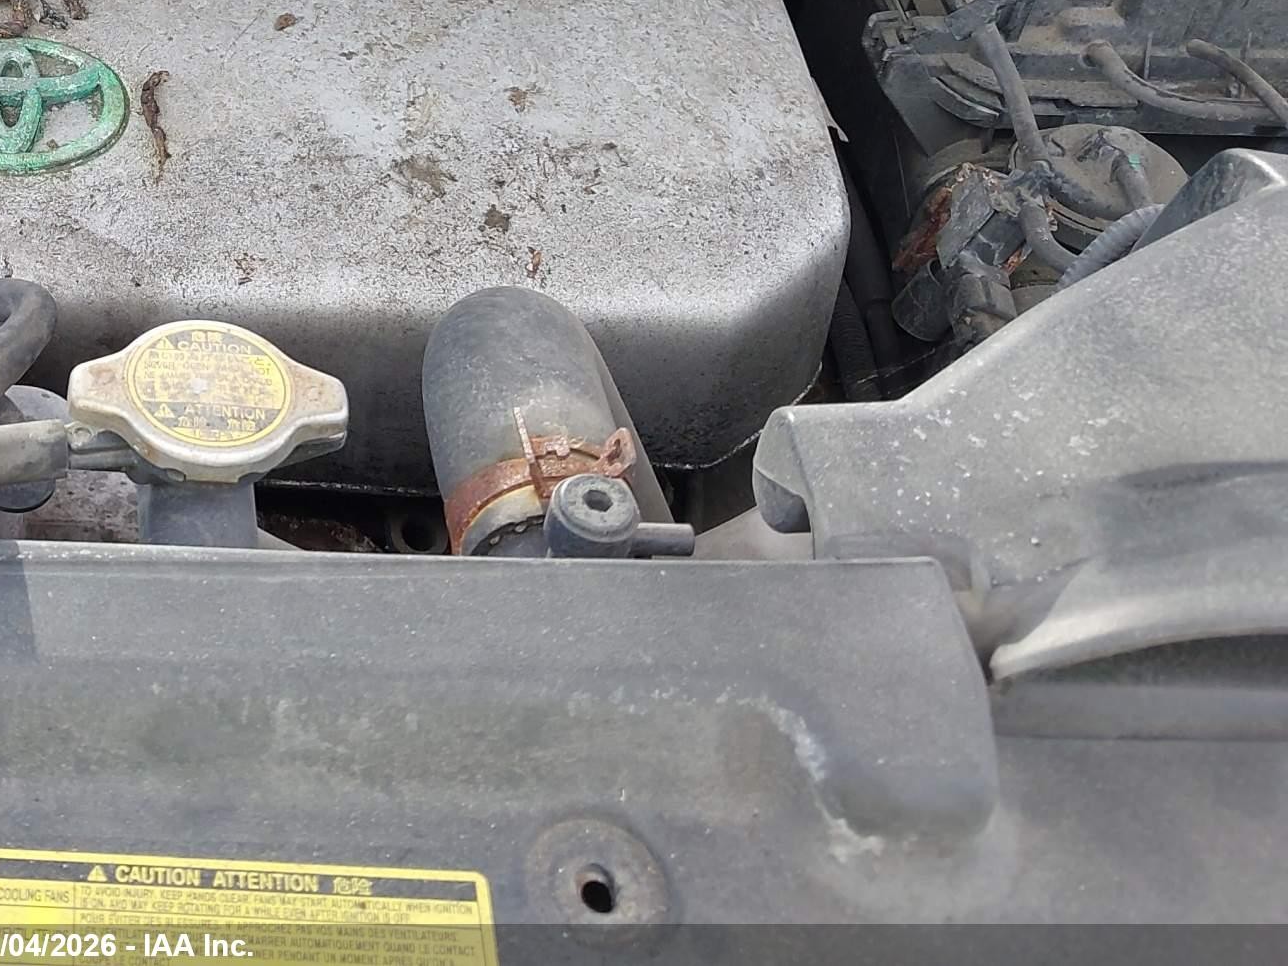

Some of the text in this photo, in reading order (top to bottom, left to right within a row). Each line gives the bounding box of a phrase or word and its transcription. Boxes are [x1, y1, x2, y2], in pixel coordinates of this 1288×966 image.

[177, 341, 252, 354] CAUTION
[184, 403, 265, 420] ATTENTION
[115, 865, 200, 886] CAUTION
[213, 870, 319, 892] ATTENTION
[44, 890, 70, 903] FANS
[80, 885, 91, 896] TO
[96, 886, 121, 897] AVOID
[160, 889, 183, 900] KEEP
[186, 891, 216, 902] HANDS
[254, 893, 278, 905] FANS
[279, 895, 297, 906] MAY
[298, 896, 326, 908] START
[331, 898, 402, 912] AUTOMTICALLY
[405, 902, 431, 913] WHEN
[433, 902, 473, 915] IGNITION
[110, 899, 127, 909] AND
[131, 900, 148, 910] MAY
[152, 901, 175, 911] KEEP
[177, 902, 220, 914] ROTATING
[223, 903, 241, 914] FOR
[254, 905, 279, 916] WHILE
[281, 907, 306, 918] EVEN
[309, 909, 337, 921] AFTER
[340, 911, 380, 922] IGNITION
[80, 913, 105, 923] POUR
[336, 926, 362, 937] MAINS
[367, 928, 386, 939] DES
[383, 941, 415, 954] QUAND
[419, 943, 429, 954] LE
[432, 944, 475, 957] CONTACT
[339, 953, 379, 965] MOMENT
